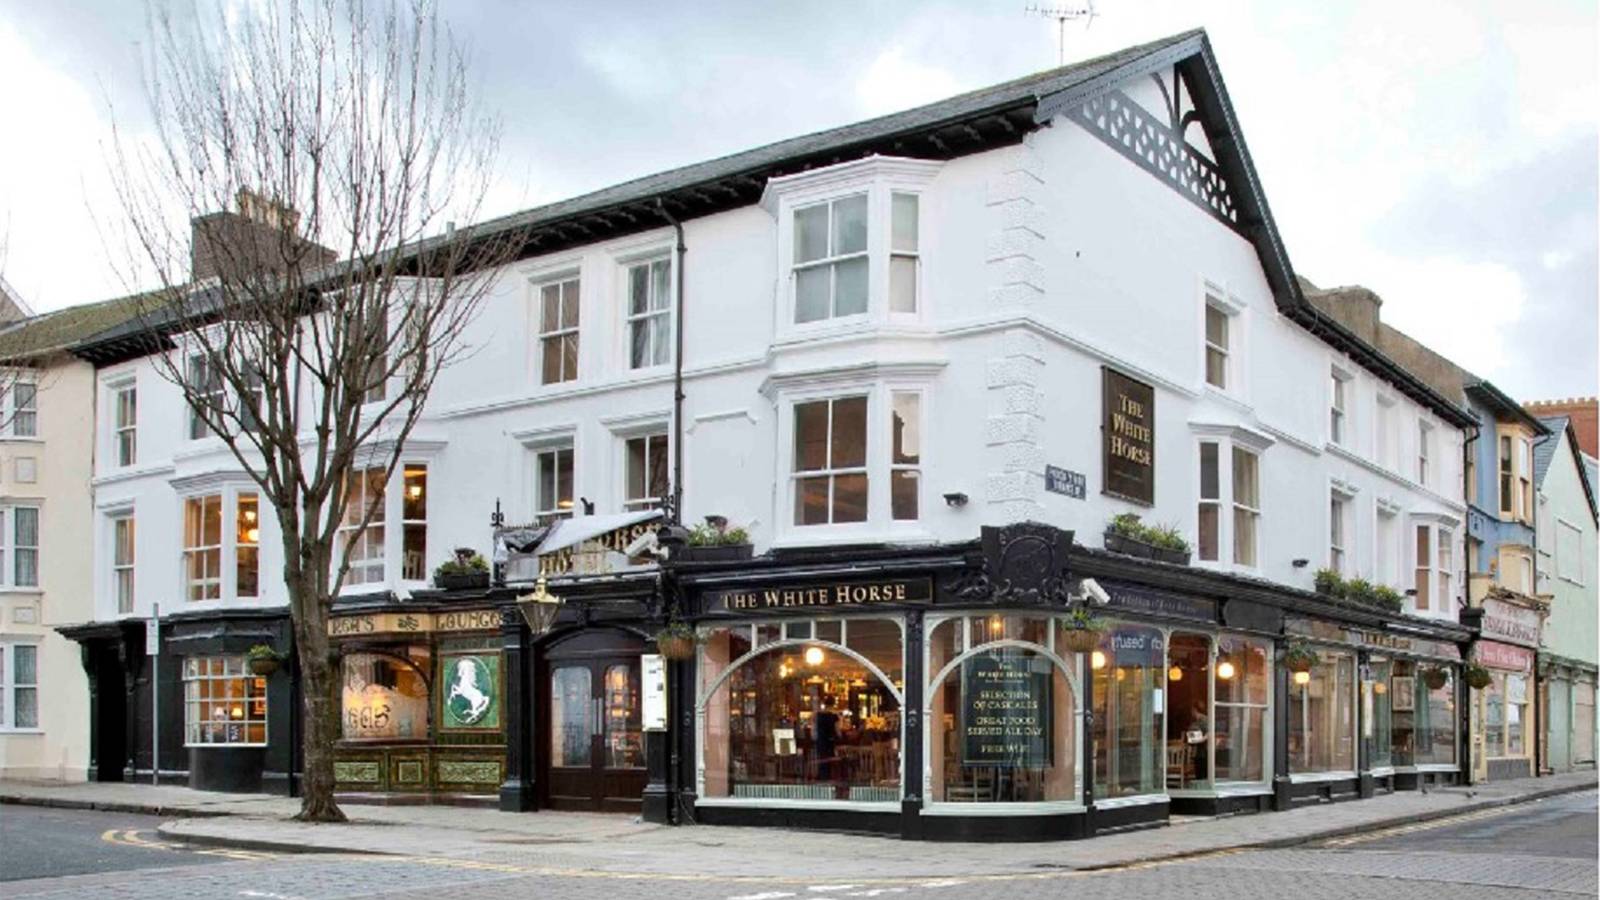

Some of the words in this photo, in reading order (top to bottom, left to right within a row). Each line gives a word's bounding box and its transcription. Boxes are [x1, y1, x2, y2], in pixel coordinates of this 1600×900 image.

[1119, 393, 1144, 418] THE
[1112, 412, 1151, 443] WHITE
[1110, 435, 1151, 467] HORSE
[720, 592, 757, 609] THE
[765, 588, 828, 607] WHITE
[836, 584, 906, 604] HORSE
